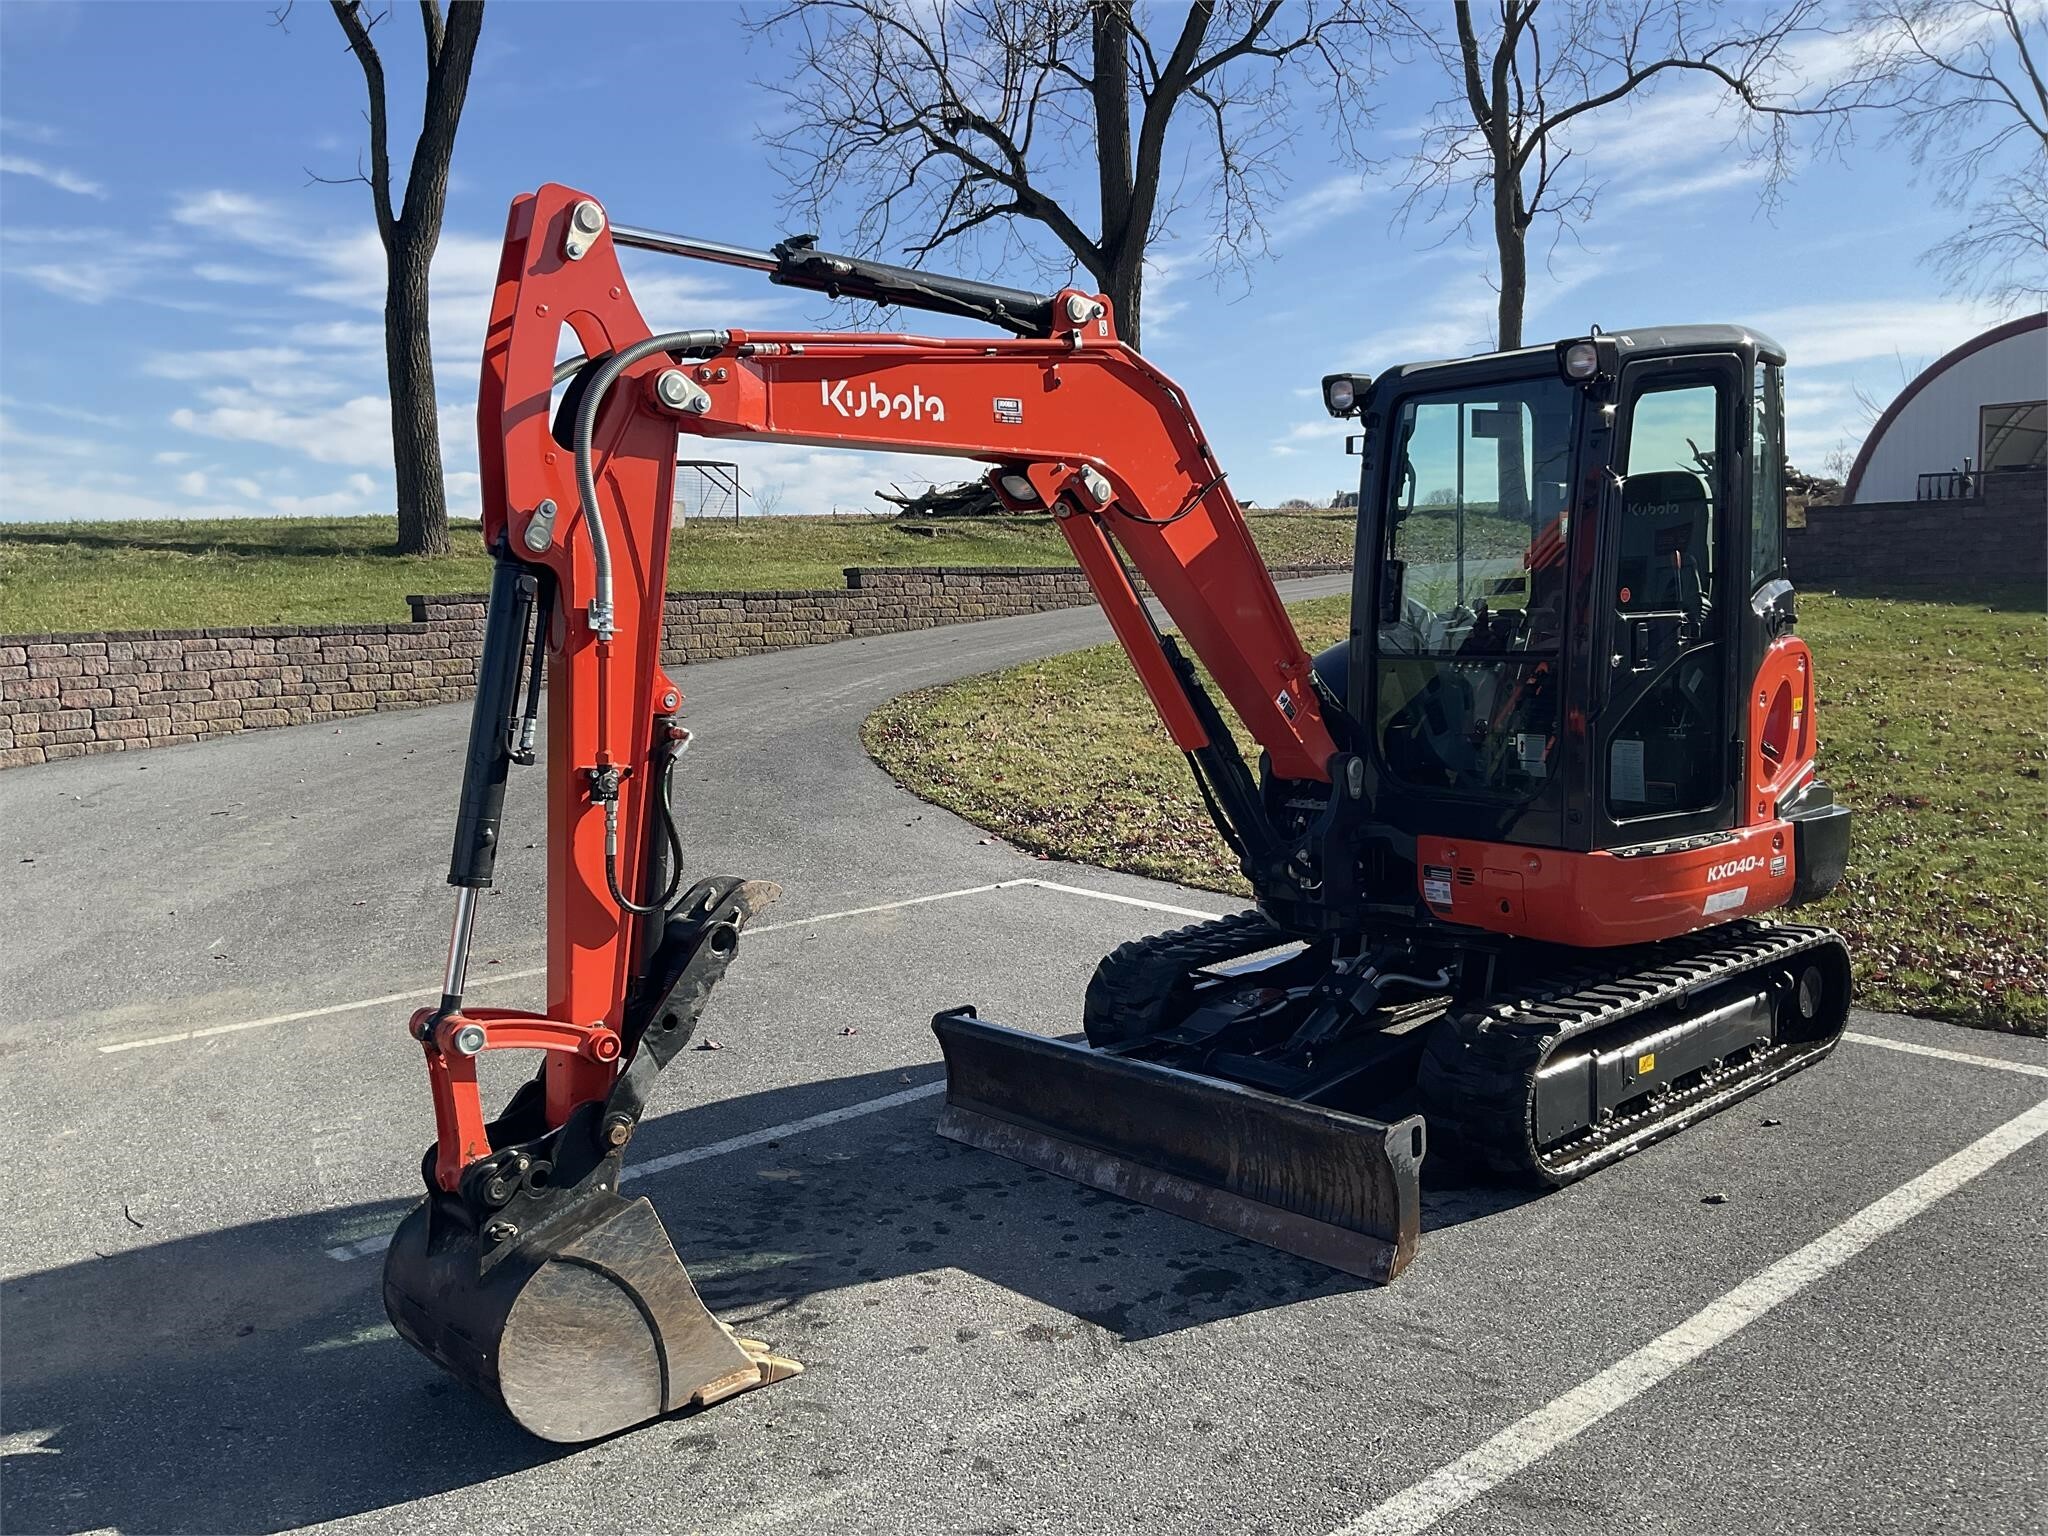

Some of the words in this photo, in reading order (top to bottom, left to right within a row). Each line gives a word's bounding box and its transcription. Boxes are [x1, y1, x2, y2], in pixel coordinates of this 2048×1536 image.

[821, 379, 945, 422] Kubota
[1628, 501, 1680, 516] Kubota
[1707, 856, 1765, 883] KX040-4
